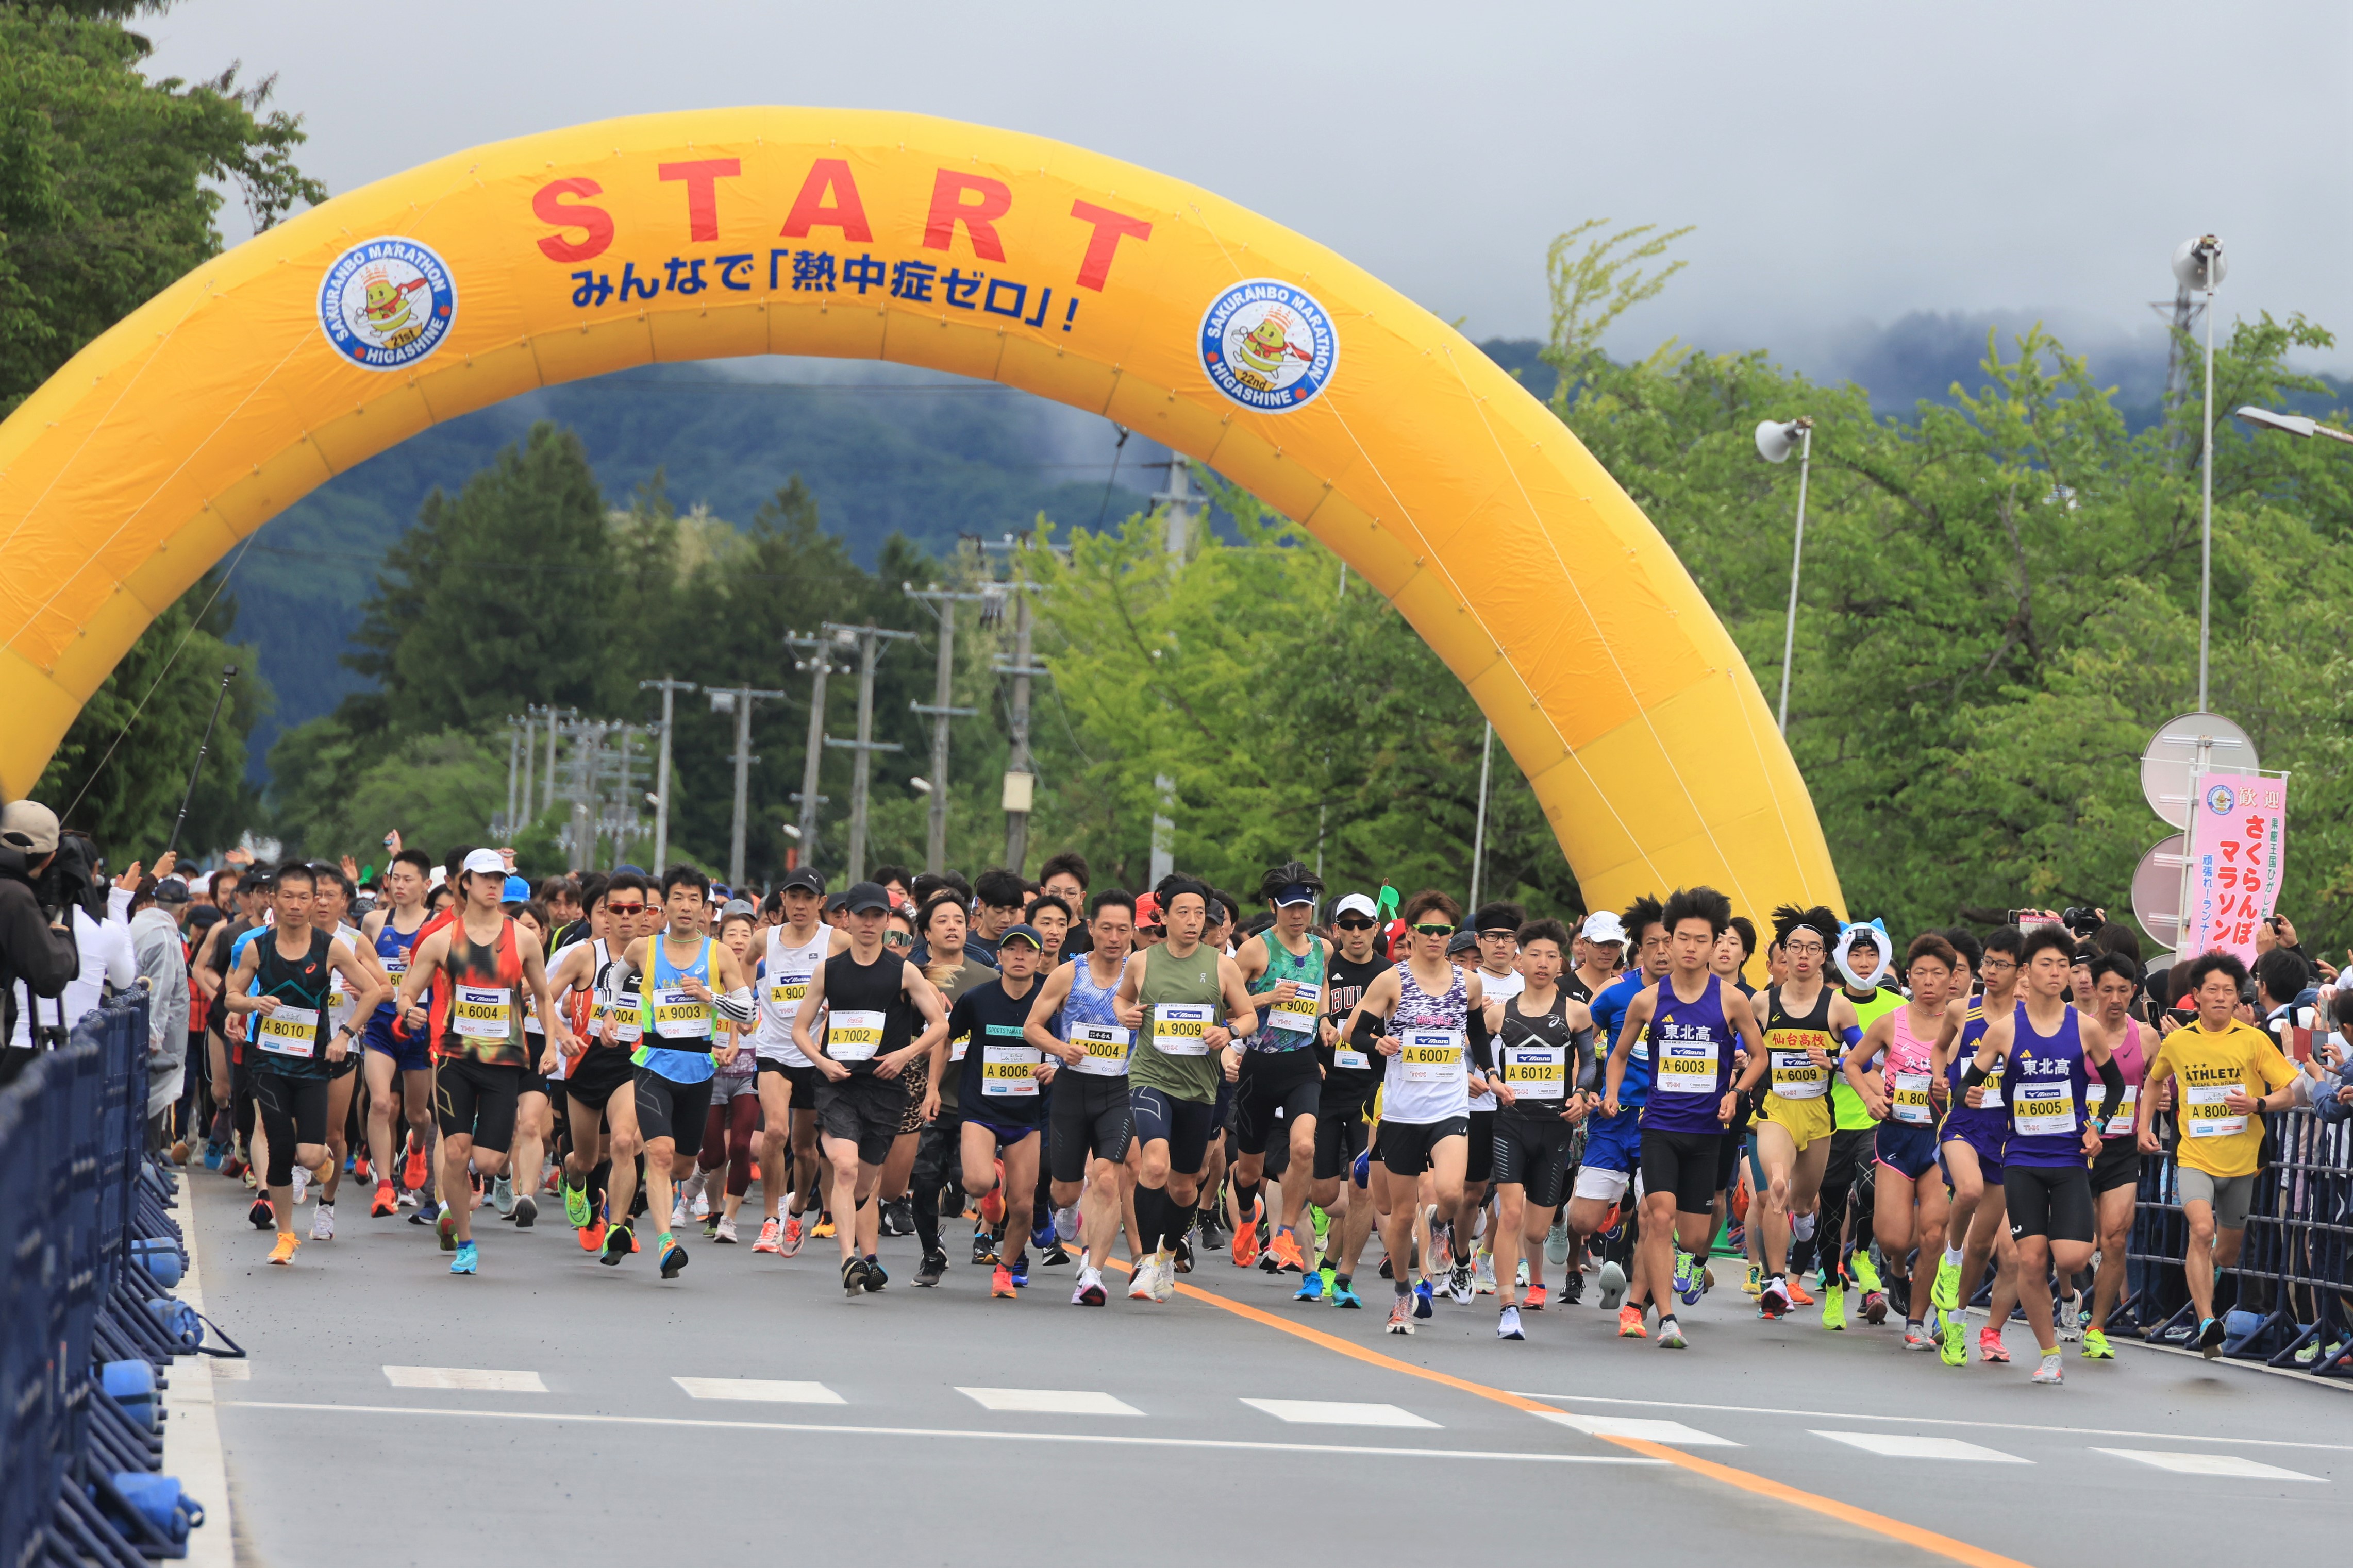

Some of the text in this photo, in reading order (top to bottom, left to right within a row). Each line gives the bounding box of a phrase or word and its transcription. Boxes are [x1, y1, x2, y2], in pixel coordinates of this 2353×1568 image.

[532, 158, 1153, 292] START
[326, 244, 447, 342] SAKURANBO MARATHON
[391, 328, 414, 347] 21st
[1207, 286, 1330, 380] SAKURANBO MARATHON
[366, 318, 444, 363] HIGASHINE
[1211, 362, 1292, 406] HIGASHINE
[1240, 371, 1267, 391] 22nd
[2239, 786, 2280, 810] 歓迎
[2232, 815, 2265, 945] さくらんぼ
[775, 987, 808, 1000] A 900
[458, 1004, 497, 1019] A 6004
[659, 1006, 700, 1020] A 9003
[1287, 1000, 1314, 1015] 9002
[615, 1011, 634, 1023] 004
[1416, 1015, 1454, 1025] 新庄最上
[264, 1020, 304, 1037] A 8010
[1158, 1023, 1201, 1036] A 9009
[1664, 1024, 1711, 1041] 東北高
[832, 1030, 870, 1042] A 7002
[1773, 1032, 1826, 1047] 仙台高校
[1340, 1040, 1347, 1049] A
[1406, 1049, 1449, 1062] A 6007
[1905, 1056, 1931, 1069] みは
[987, 1065, 1028, 1077] A 8006
[1509, 1067, 1551, 1080] A 6012
[1663, 1060, 1705, 1073] A 6003
[2022, 1058, 2071, 1076] 東北高
[1777, 1069, 1817, 1082] A 6009
[2186, 1068, 2241, 1082] ATHLETA
[1897, 1092, 1928, 1105] A 800
[2018, 1101, 2062, 1115] A 6005
[2193, 1106, 2200, 1118] A
